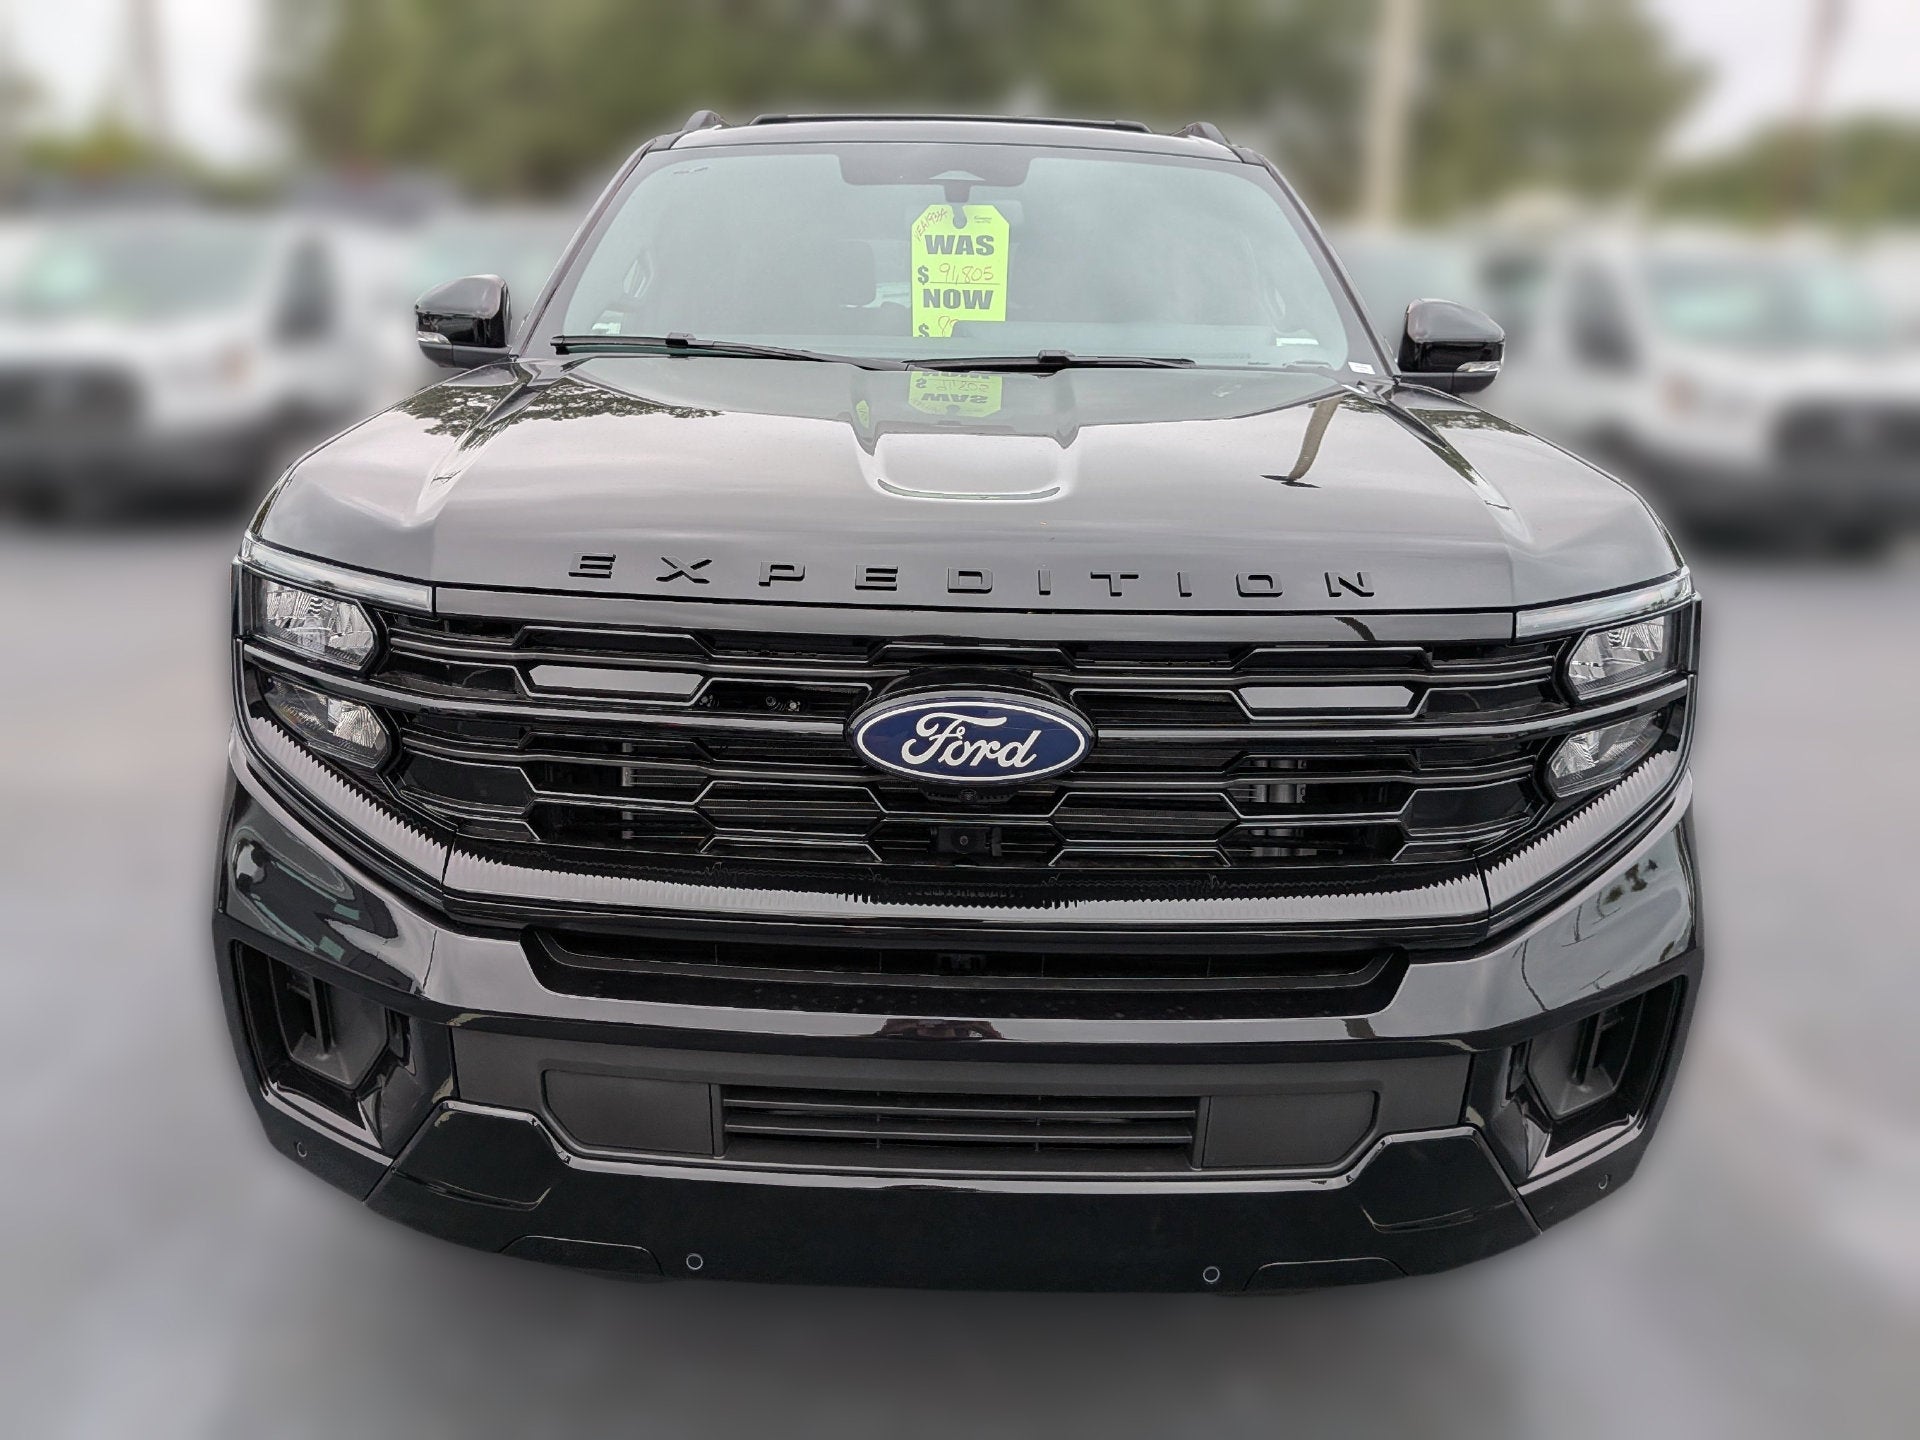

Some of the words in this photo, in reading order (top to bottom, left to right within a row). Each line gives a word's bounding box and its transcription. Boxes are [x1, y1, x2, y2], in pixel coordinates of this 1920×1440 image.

[924, 234, 995, 256] WAS
[917, 265, 930, 285] $
[922, 288, 994, 310] NOW
[918, 322, 930, 338] $
[568, 552, 1375, 598] EXPEDITION
[901, 712, 1042, 768] Ford
